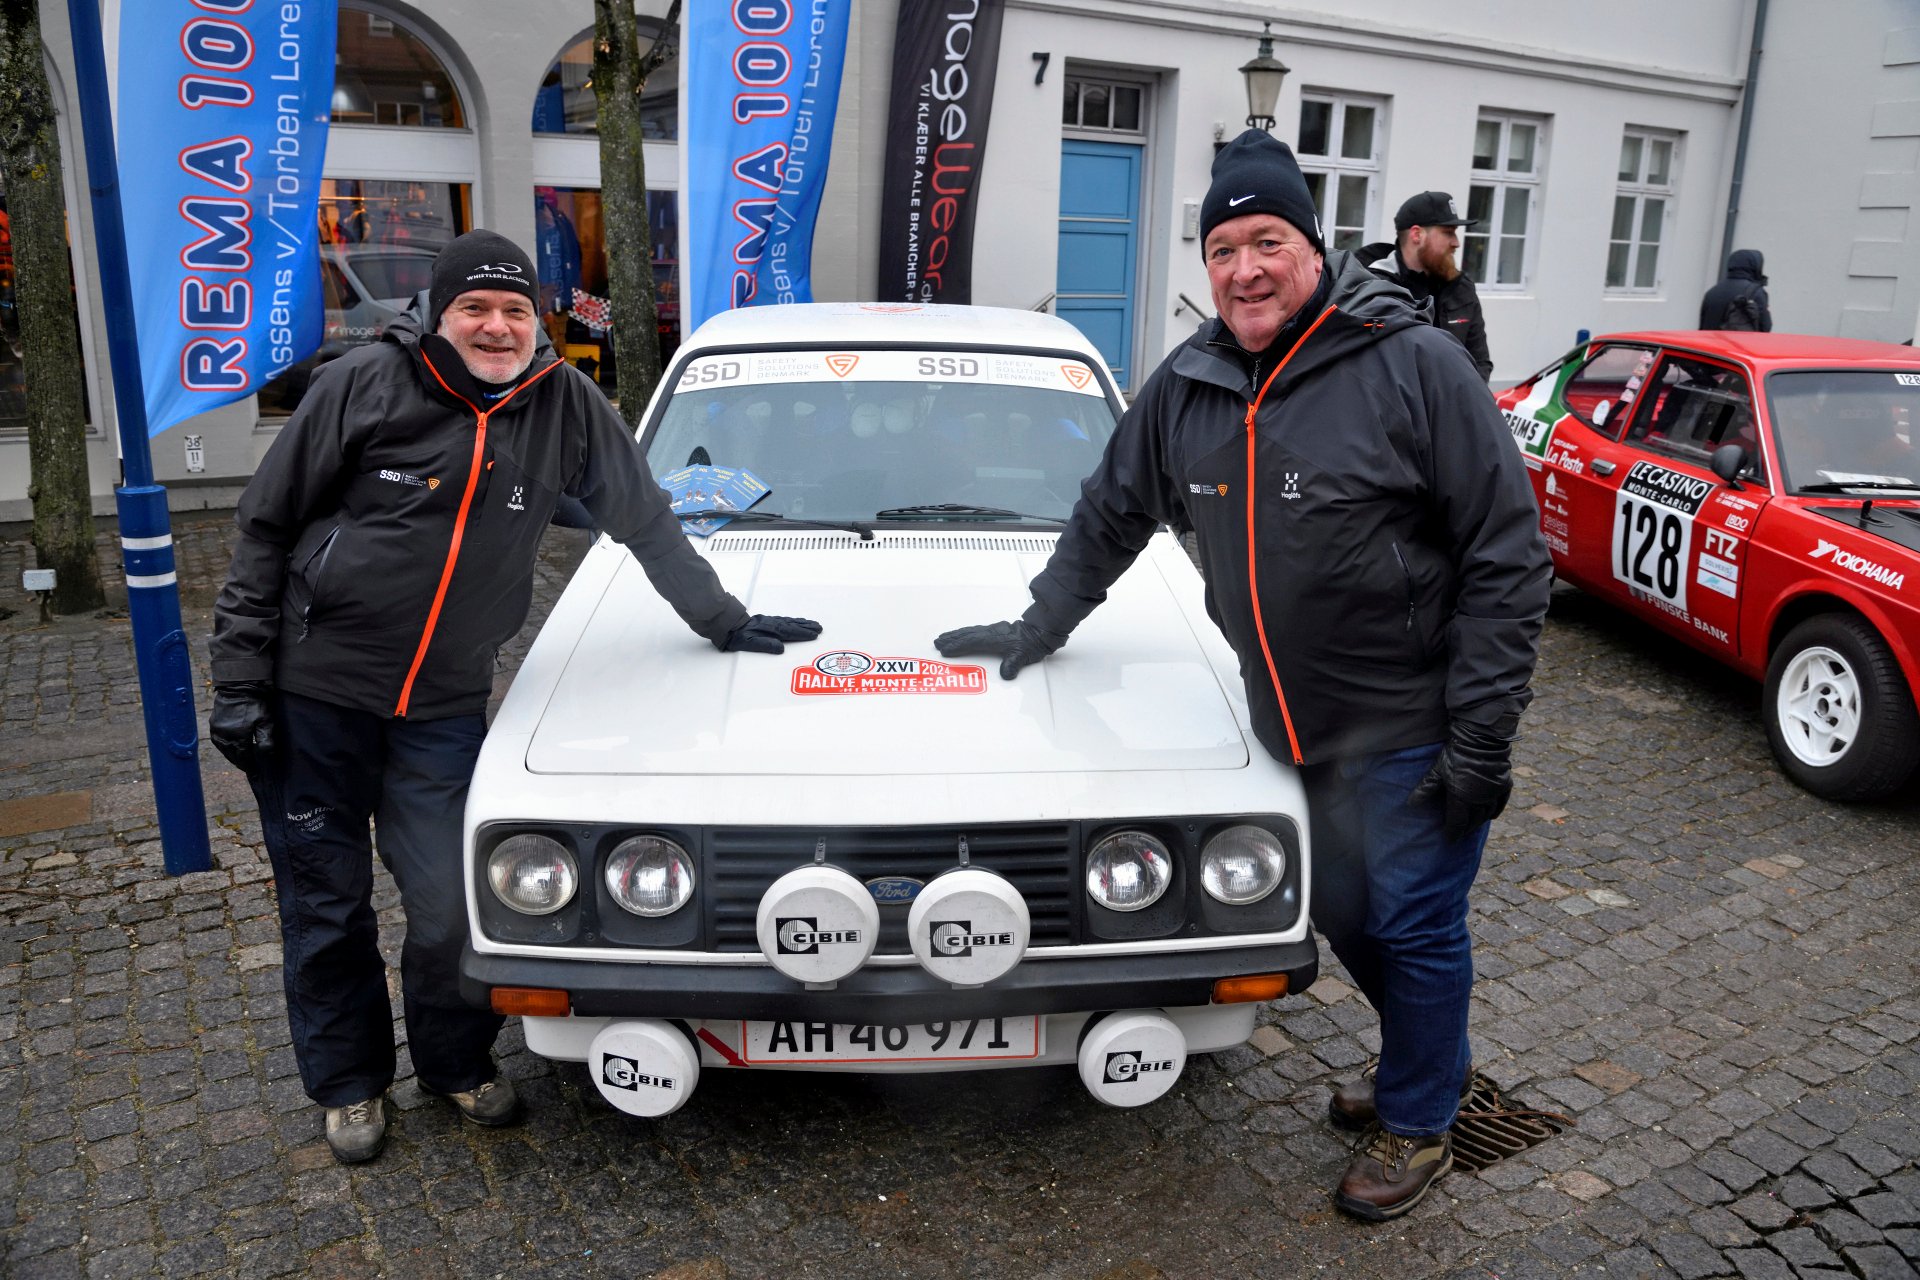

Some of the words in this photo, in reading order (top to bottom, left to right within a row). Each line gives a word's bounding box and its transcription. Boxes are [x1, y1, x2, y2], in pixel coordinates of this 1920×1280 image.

[270, 0, 301, 80] Lore
[179, 0, 255, 110] 10
[1032, 52, 1050, 85] 7
[920, 83, 930, 96] VI
[914, 102, 930, 165] KLÆDER
[911, 170, 923, 207] ALLE
[906, 213, 921, 289] BRANCHER
[180, 136, 254, 392] REMA
[466, 273, 502, 281] WHISTLER
[681, 361, 741, 386] SSD
[757, 363, 819, 372] SOLUTIONS
[757, 370, 810, 379] DENMARK
[918, 357, 979, 377] SSD
[995, 359, 1034, 368] SAFETY
[995, 366, 1057, 377] SOLUTIONS
[995, 373, 1049, 383] DENMARK
[187, 437, 201, 448] 38
[191, 451, 199, 461] 11
[1546, 446, 1559, 464] La
[380, 469, 401, 482] SSD
[1630, 461, 1648, 482] LE
[1646, 464, 1708, 500] CASINO
[1622, 500, 1683, 599] 128
[1705, 527, 1739, 560] FTZ
[1831, 548, 1905, 590] YOKOHAMA
[1647, 593, 1691, 624] FYNSKE
[1694, 616, 1729, 644] BANK
[799, 672, 855, 689] RALLYE
[861, 672, 980, 689] MONTE-CARLO
[874, 882, 912, 898] Ford
[768, 1020, 834, 1052] AH
